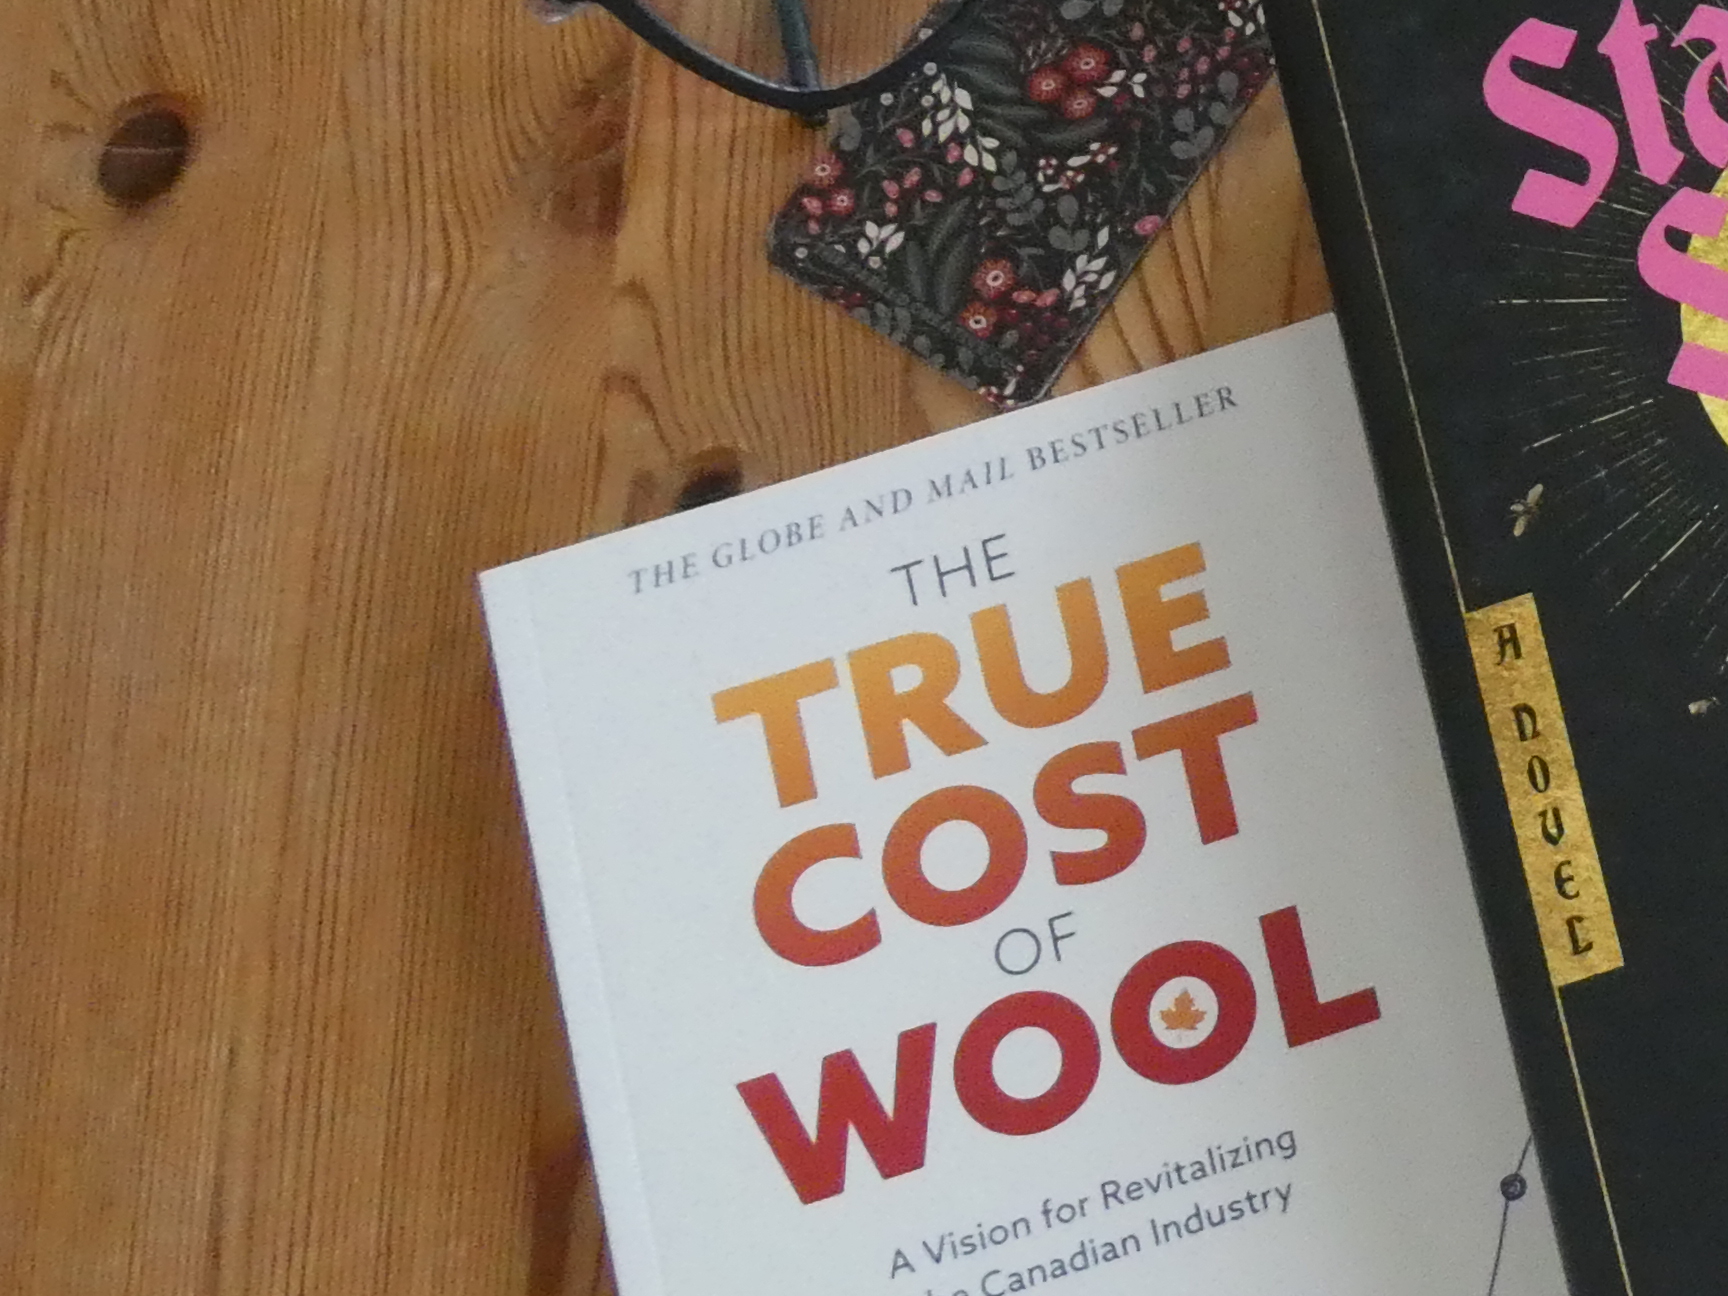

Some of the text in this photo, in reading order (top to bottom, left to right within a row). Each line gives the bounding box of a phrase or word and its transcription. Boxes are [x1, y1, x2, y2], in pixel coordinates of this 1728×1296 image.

[627, 384, 1239, 595] THE GLOBE AND MAIL BESTSELLER
[891, 534, 1016, 607] THE
[1493, 622, 1523, 667] A
[710, 542, 1232, 809] TRUE
[753, 691, 1259, 966] COST
[993, 911, 1077, 976] OF
[736, 904, 1382, 1206] WOOL
[889, 1129, 1299, 1280] A Vision for Revitalizing
[1150, 1178, 1296, 1246] Industry
